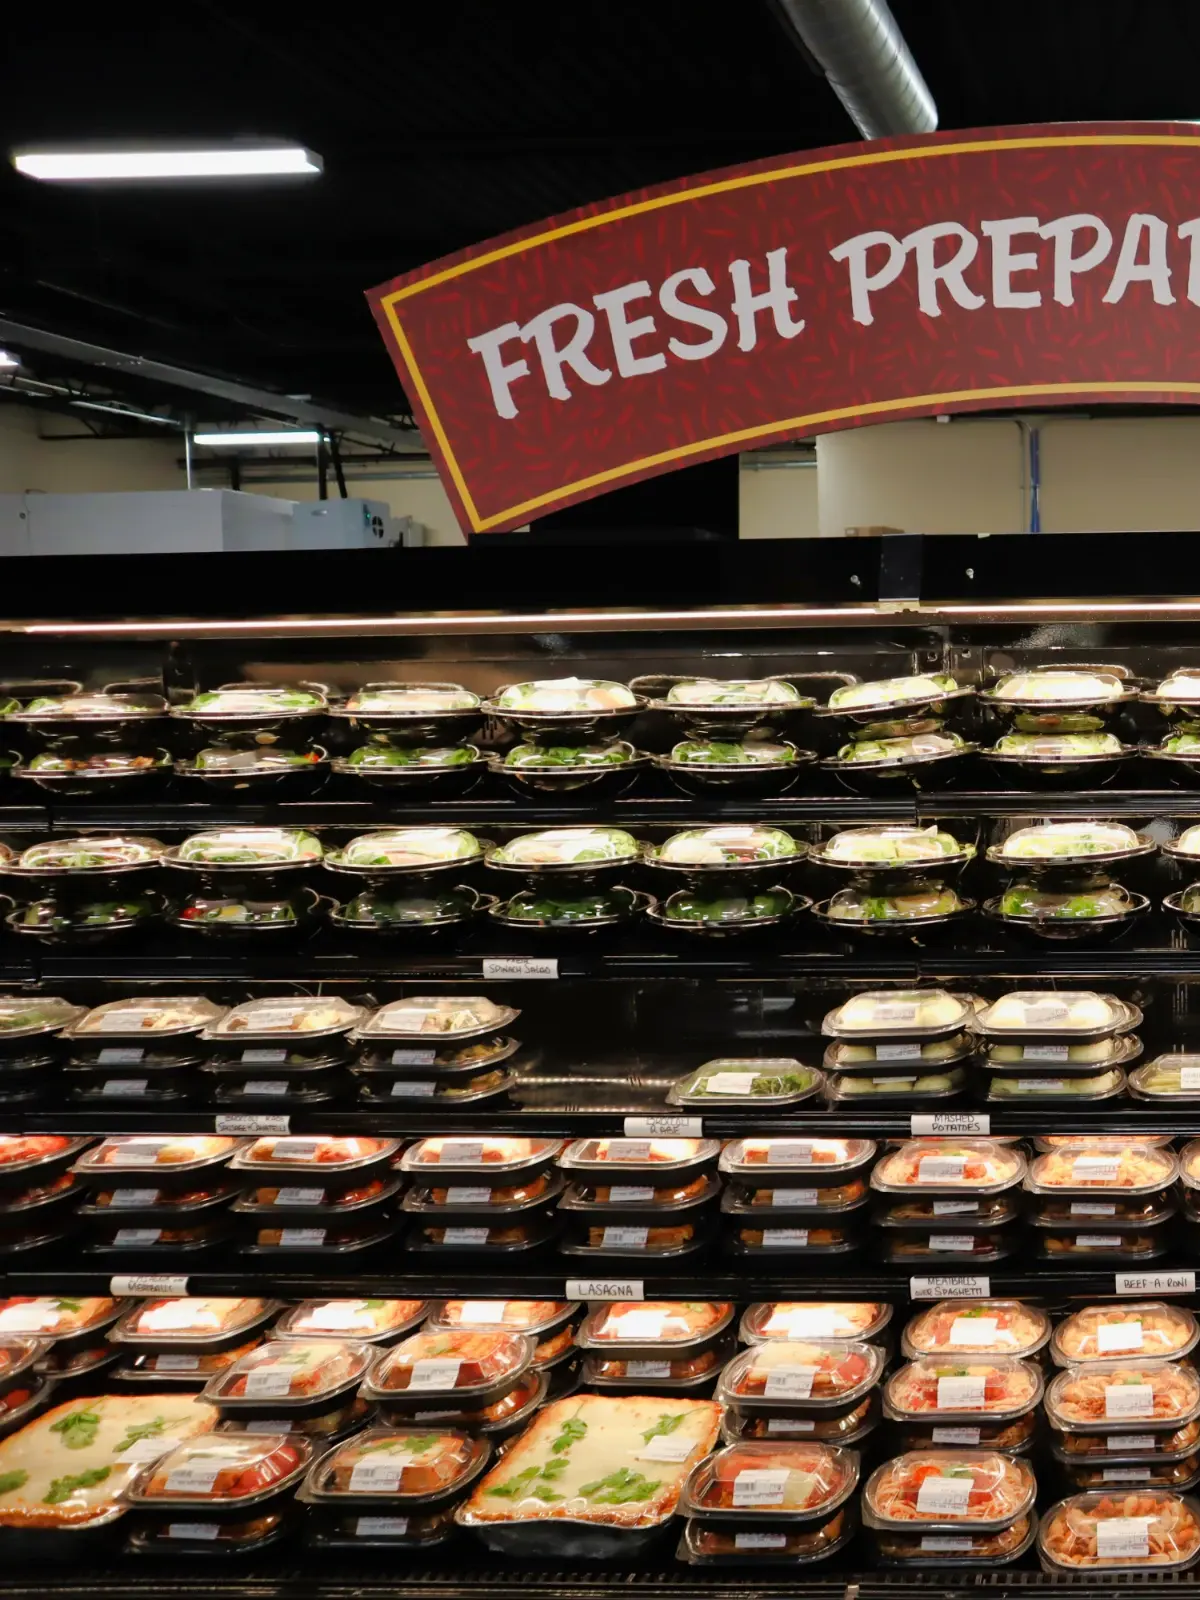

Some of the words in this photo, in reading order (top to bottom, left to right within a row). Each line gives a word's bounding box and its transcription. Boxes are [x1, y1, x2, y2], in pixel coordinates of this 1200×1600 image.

[467, 247, 805, 420] FRESH
[488, 964, 521, 974] SPINACH
[525, 964, 551, 974] SALAD
[934, 1114, 975, 1123] MASHED
[931, 1123, 981, 1132] POTATOES
[927, 1277, 977, 1286] MEATBALLS
[578, 1283, 634, 1297] LASAGNA
[934, 1287, 982, 1297] SPAGHETTI
